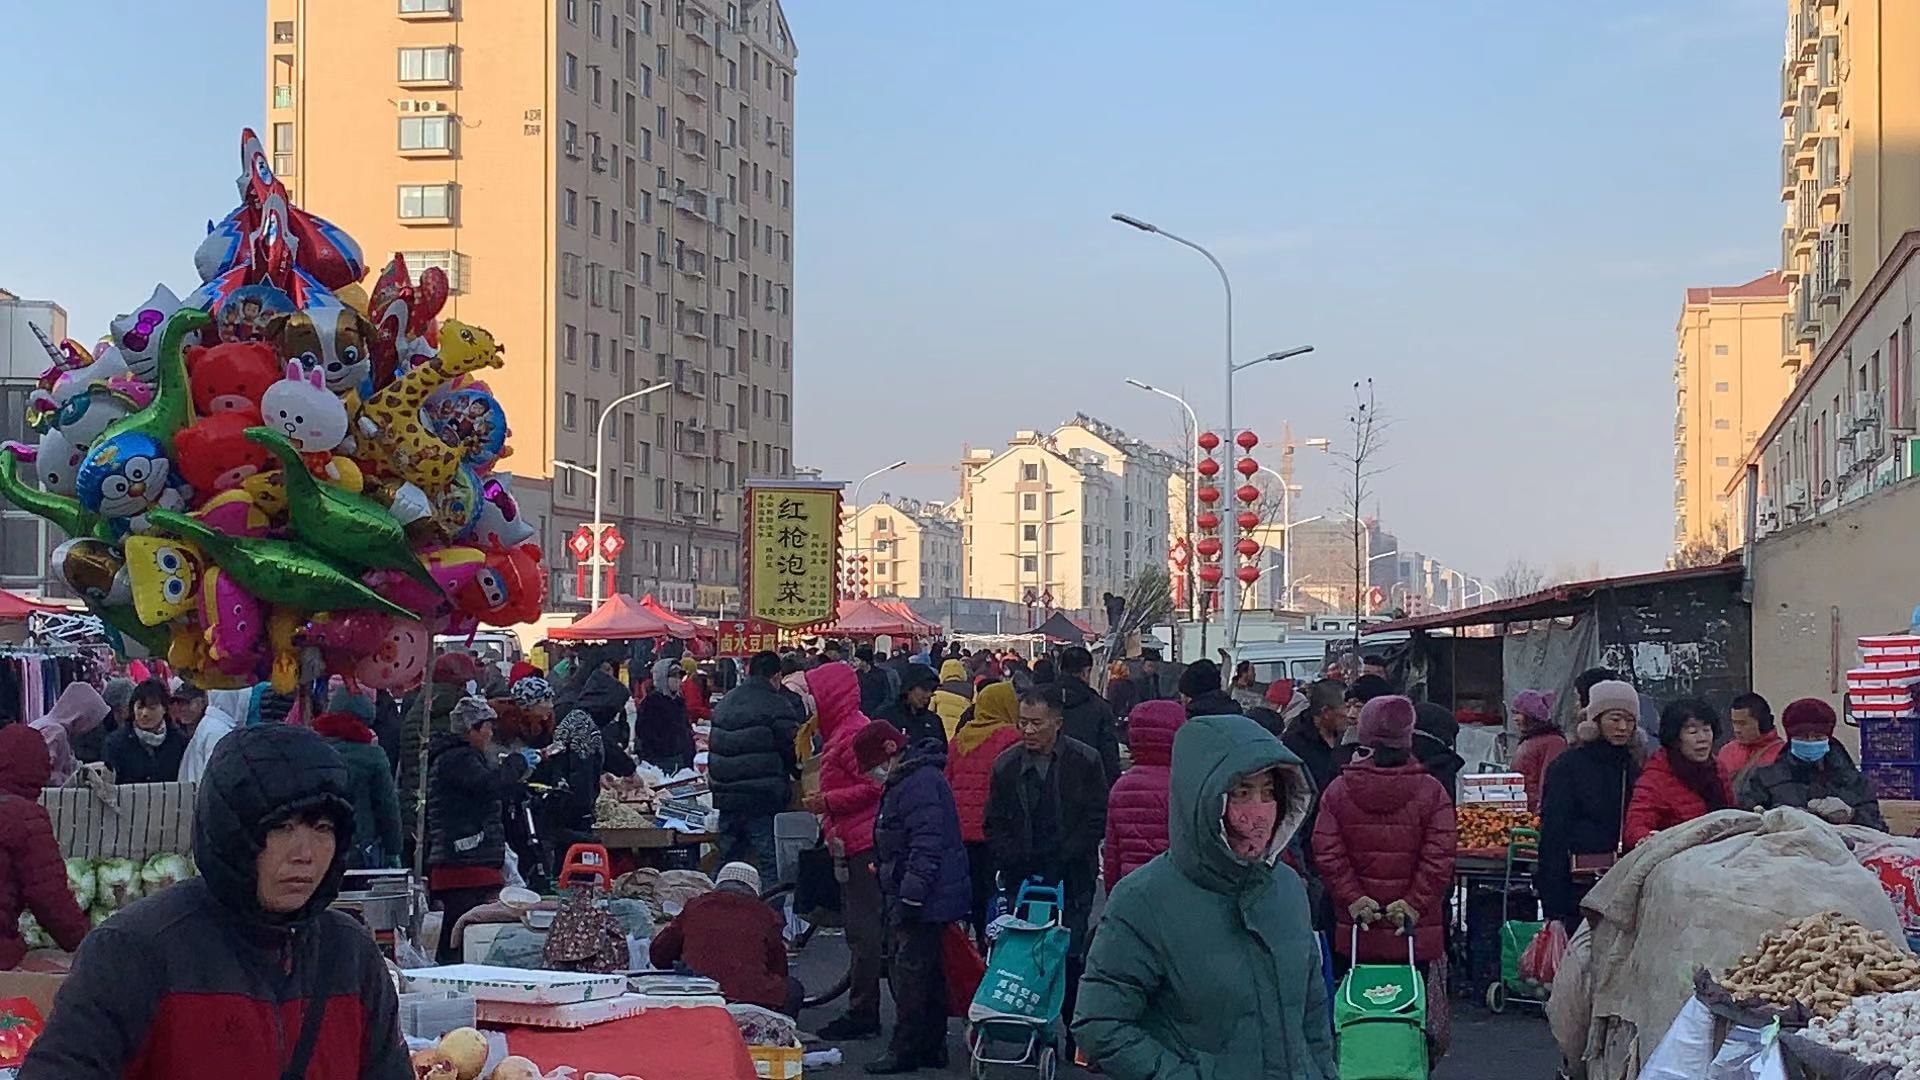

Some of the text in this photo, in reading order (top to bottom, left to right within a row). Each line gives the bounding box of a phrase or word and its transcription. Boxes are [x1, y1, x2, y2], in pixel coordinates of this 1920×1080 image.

[777, 497, 808, 604] 红枪泡菜
[720, 632, 777, 654] 卤水豆腐
